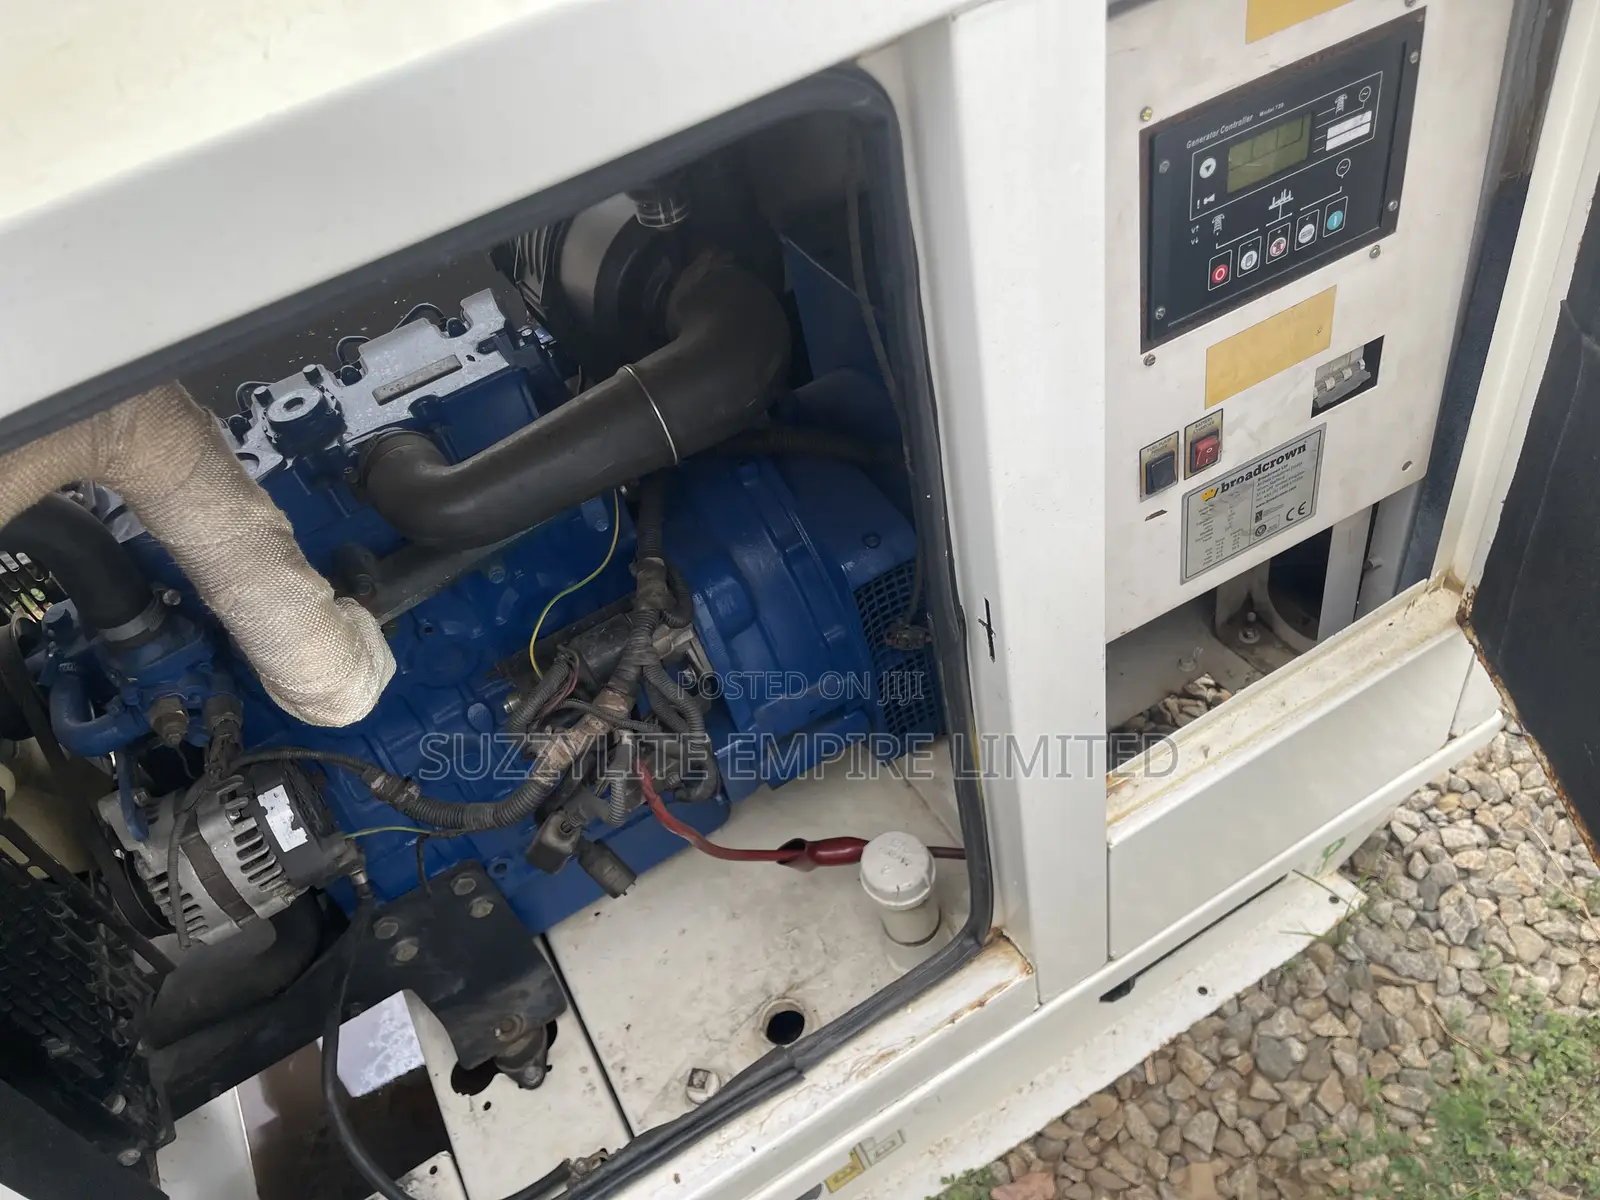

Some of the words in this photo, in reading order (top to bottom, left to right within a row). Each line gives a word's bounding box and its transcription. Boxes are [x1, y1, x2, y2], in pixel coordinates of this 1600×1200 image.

[1186, 129, 1219, 148] Generator
[1220, 114, 1254, 134] Controller
[1220, 443, 1306, 493] broadcrown
